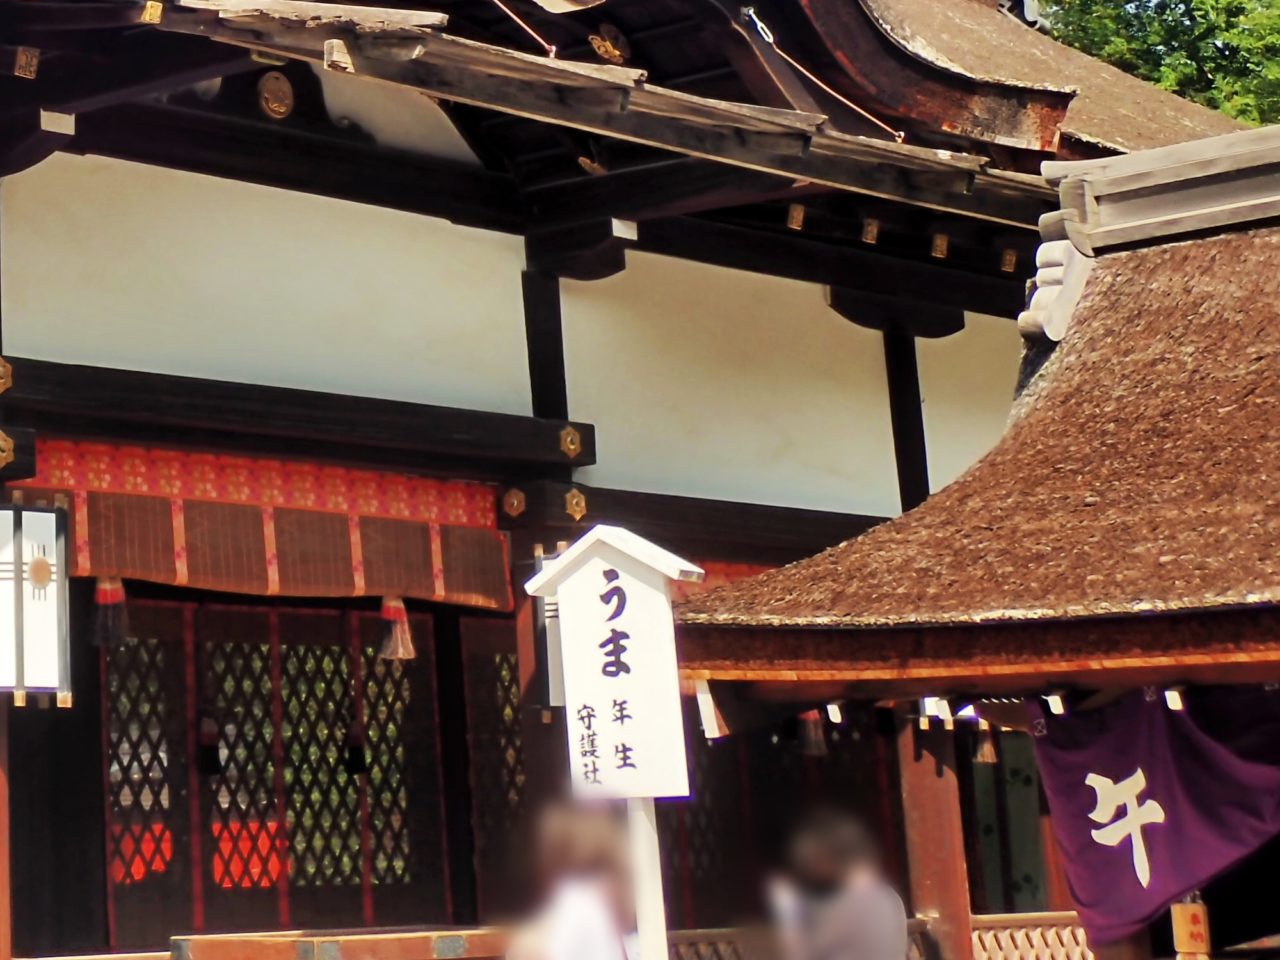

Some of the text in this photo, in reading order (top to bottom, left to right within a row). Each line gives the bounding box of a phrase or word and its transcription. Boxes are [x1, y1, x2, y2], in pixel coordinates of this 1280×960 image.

[598, 568, 637, 769] うま年生
[577, 703, 602, 785] 守護社
[1085, 767, 1165, 888] 午
